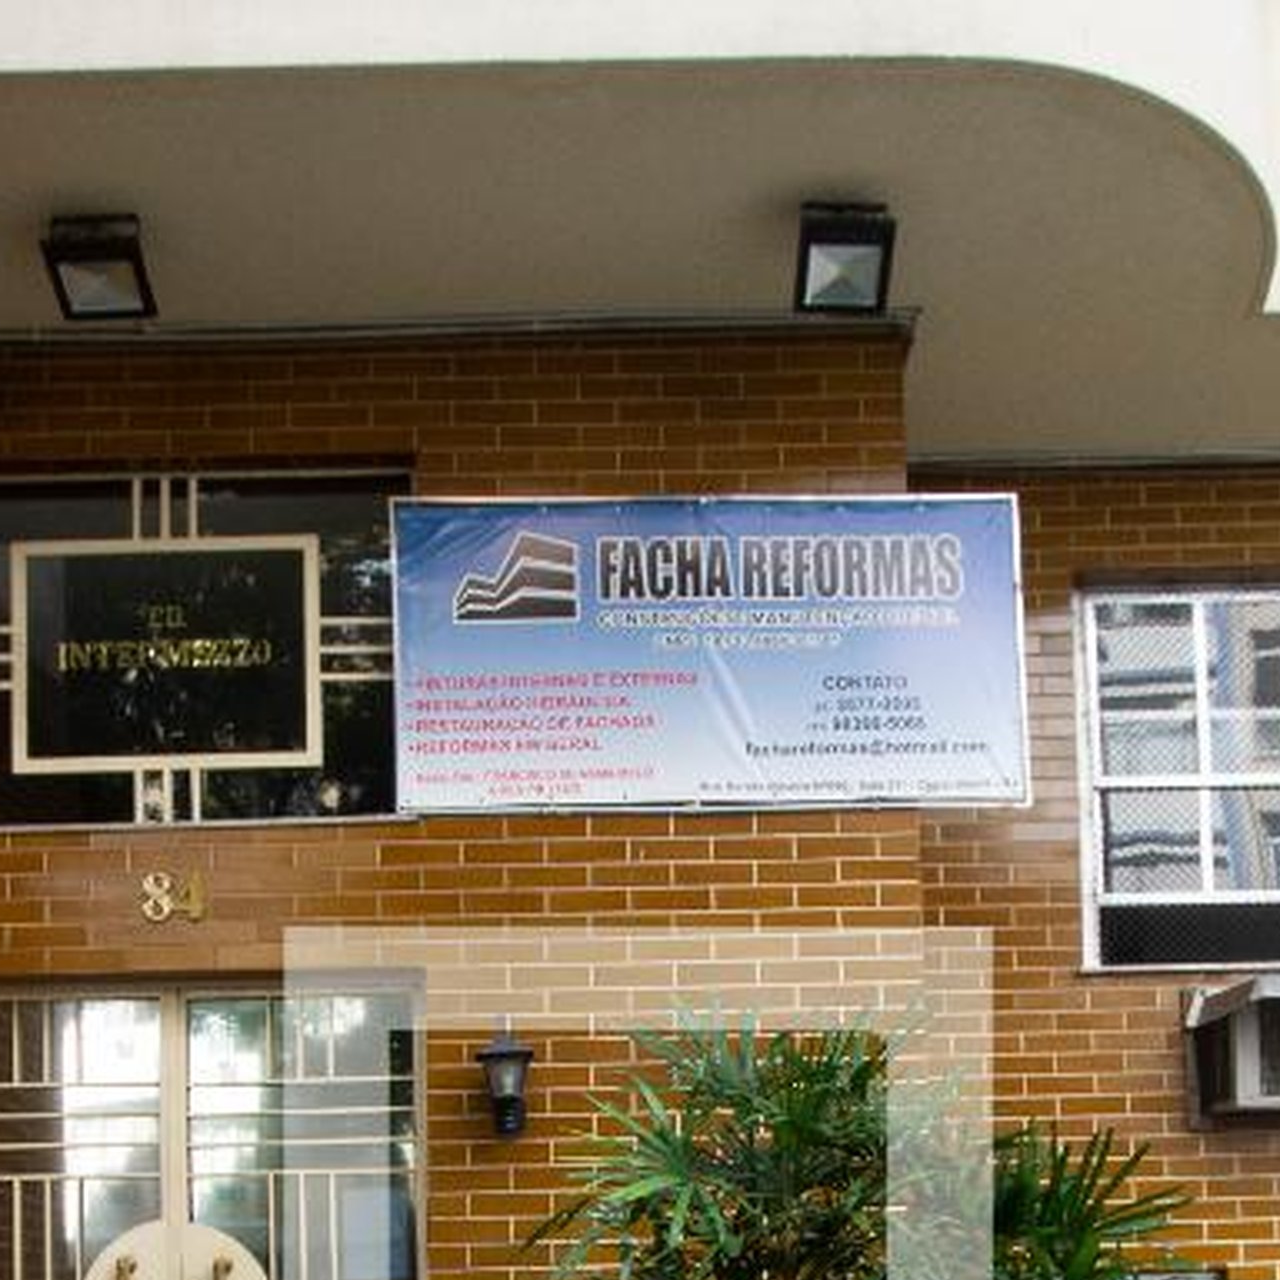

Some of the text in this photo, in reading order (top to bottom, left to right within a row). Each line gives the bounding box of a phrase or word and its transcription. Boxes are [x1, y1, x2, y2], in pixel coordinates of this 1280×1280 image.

[598, 535, 960, 599] FACHA REFORMAS
[822, 676, 908, 691] CONTATO
[143, 870, 207, 921] 84
